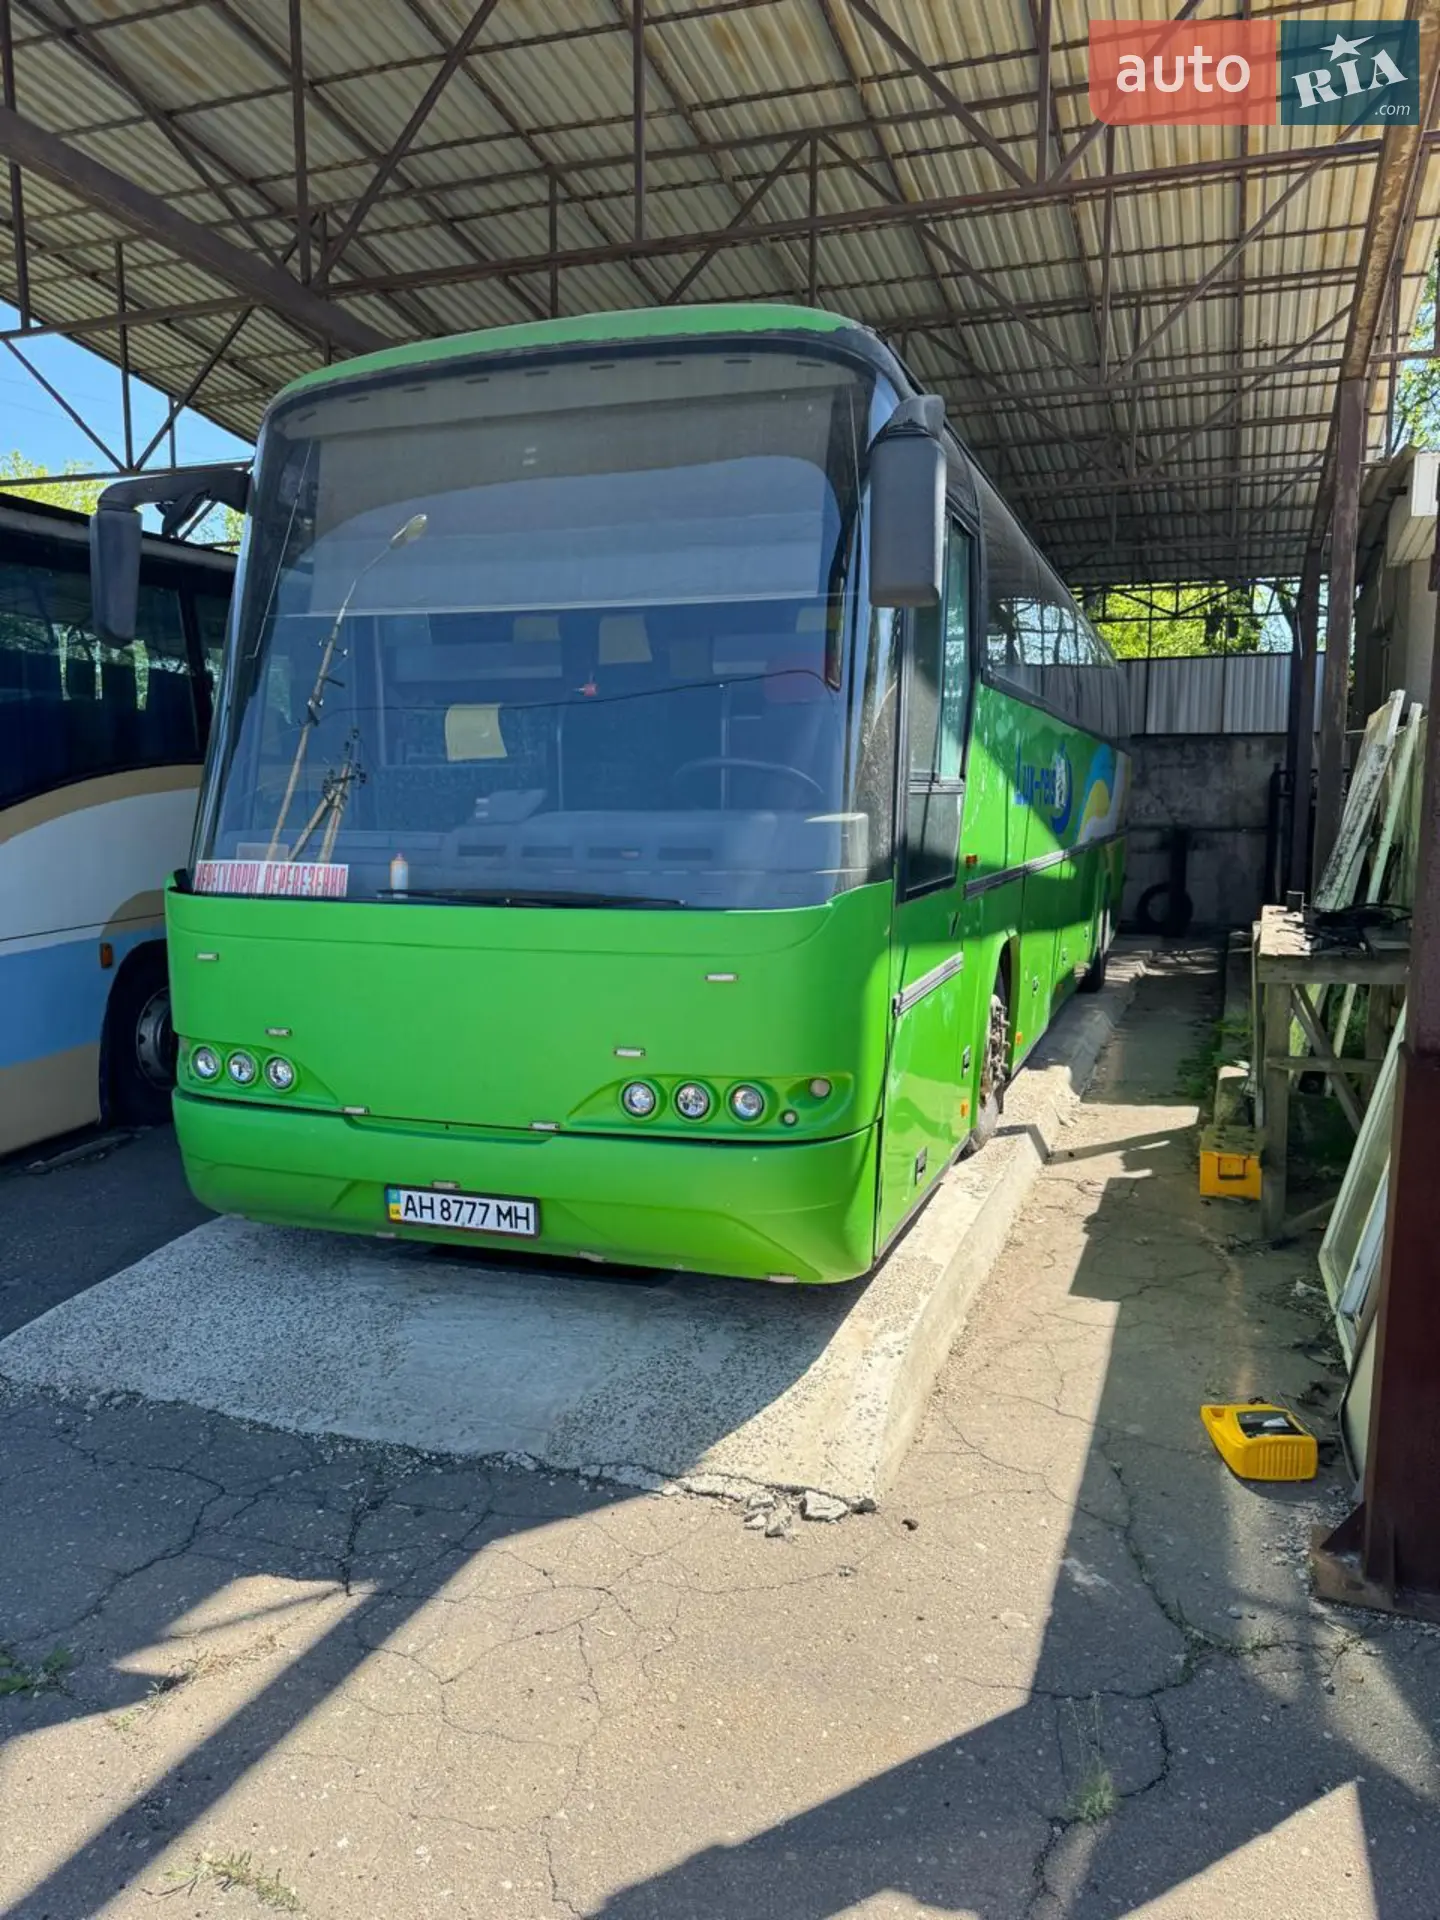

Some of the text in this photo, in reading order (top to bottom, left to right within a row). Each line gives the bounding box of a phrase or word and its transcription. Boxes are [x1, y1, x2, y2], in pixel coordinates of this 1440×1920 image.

[404, 1194, 530, 1231] AH 8777 MH
